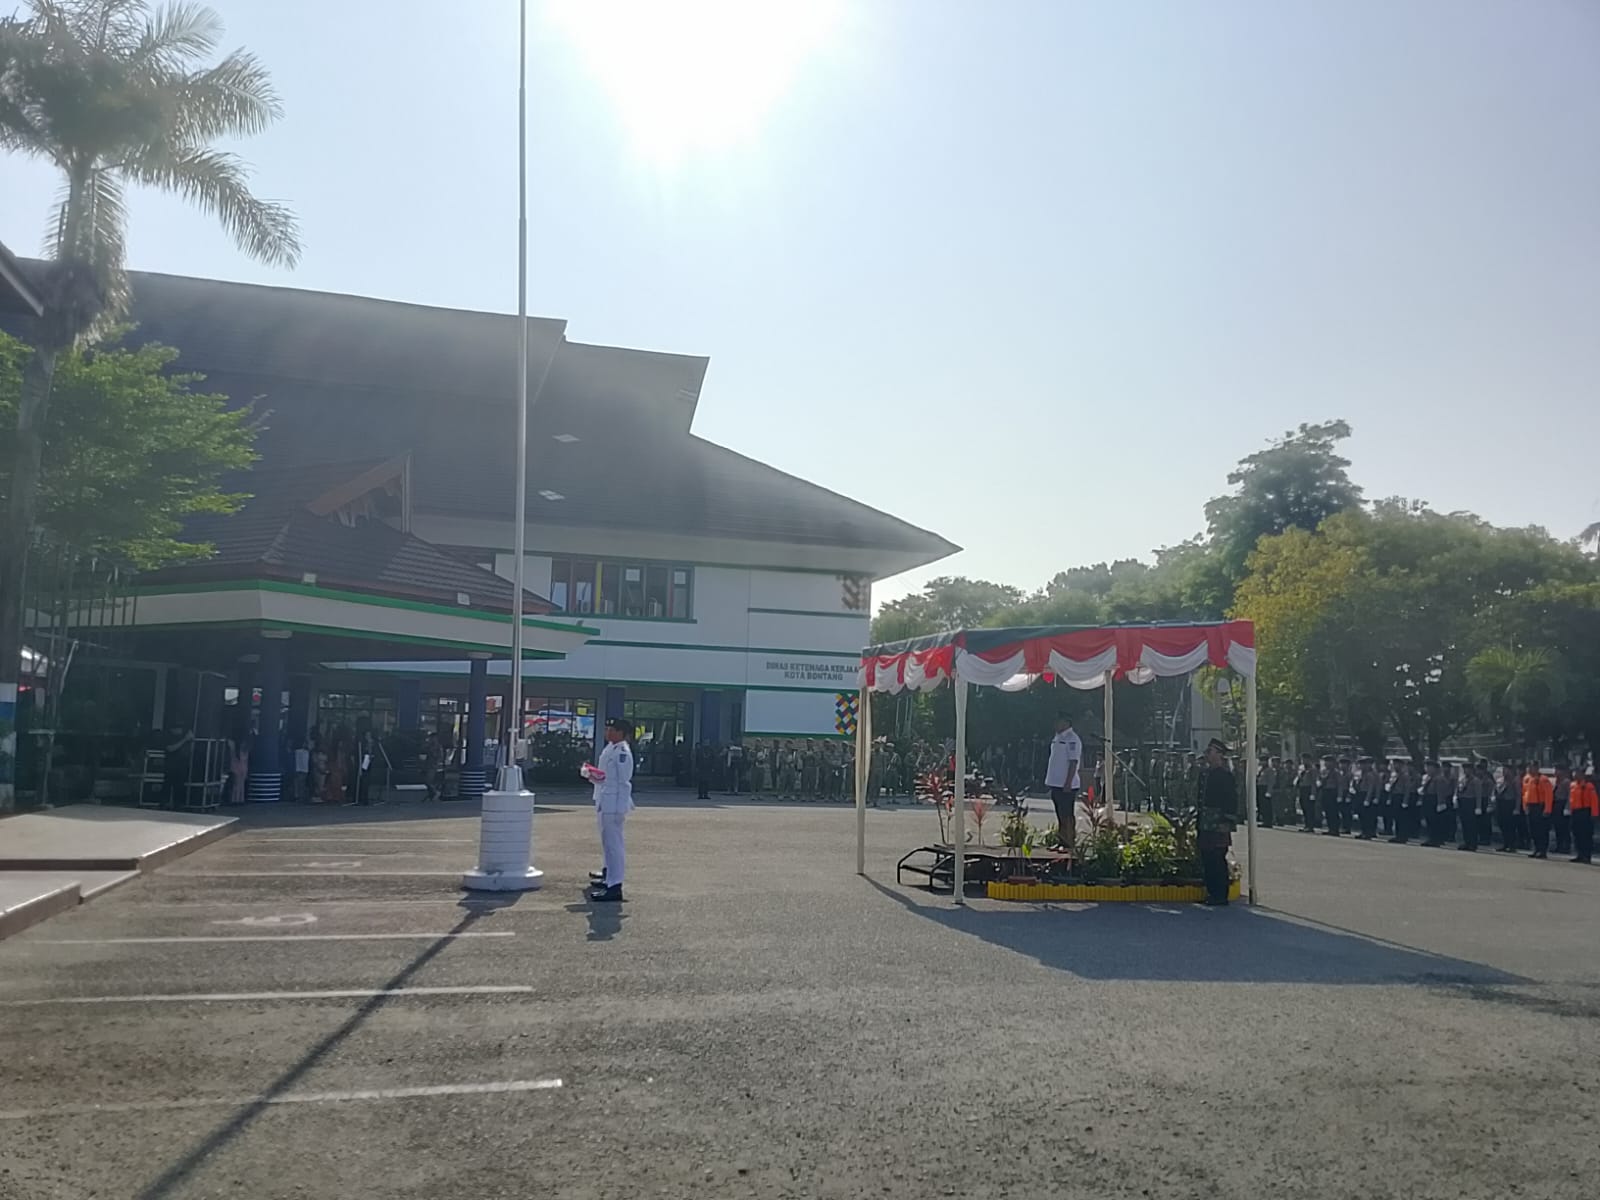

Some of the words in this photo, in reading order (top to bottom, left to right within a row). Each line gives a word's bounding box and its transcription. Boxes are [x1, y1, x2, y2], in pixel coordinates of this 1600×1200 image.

[790, 663, 829, 671] KETENAGA
[831, 665, 859, 673] KERJAA
[784, 672, 804, 680] KOTA
[807, 673, 843, 681] BONTANG
